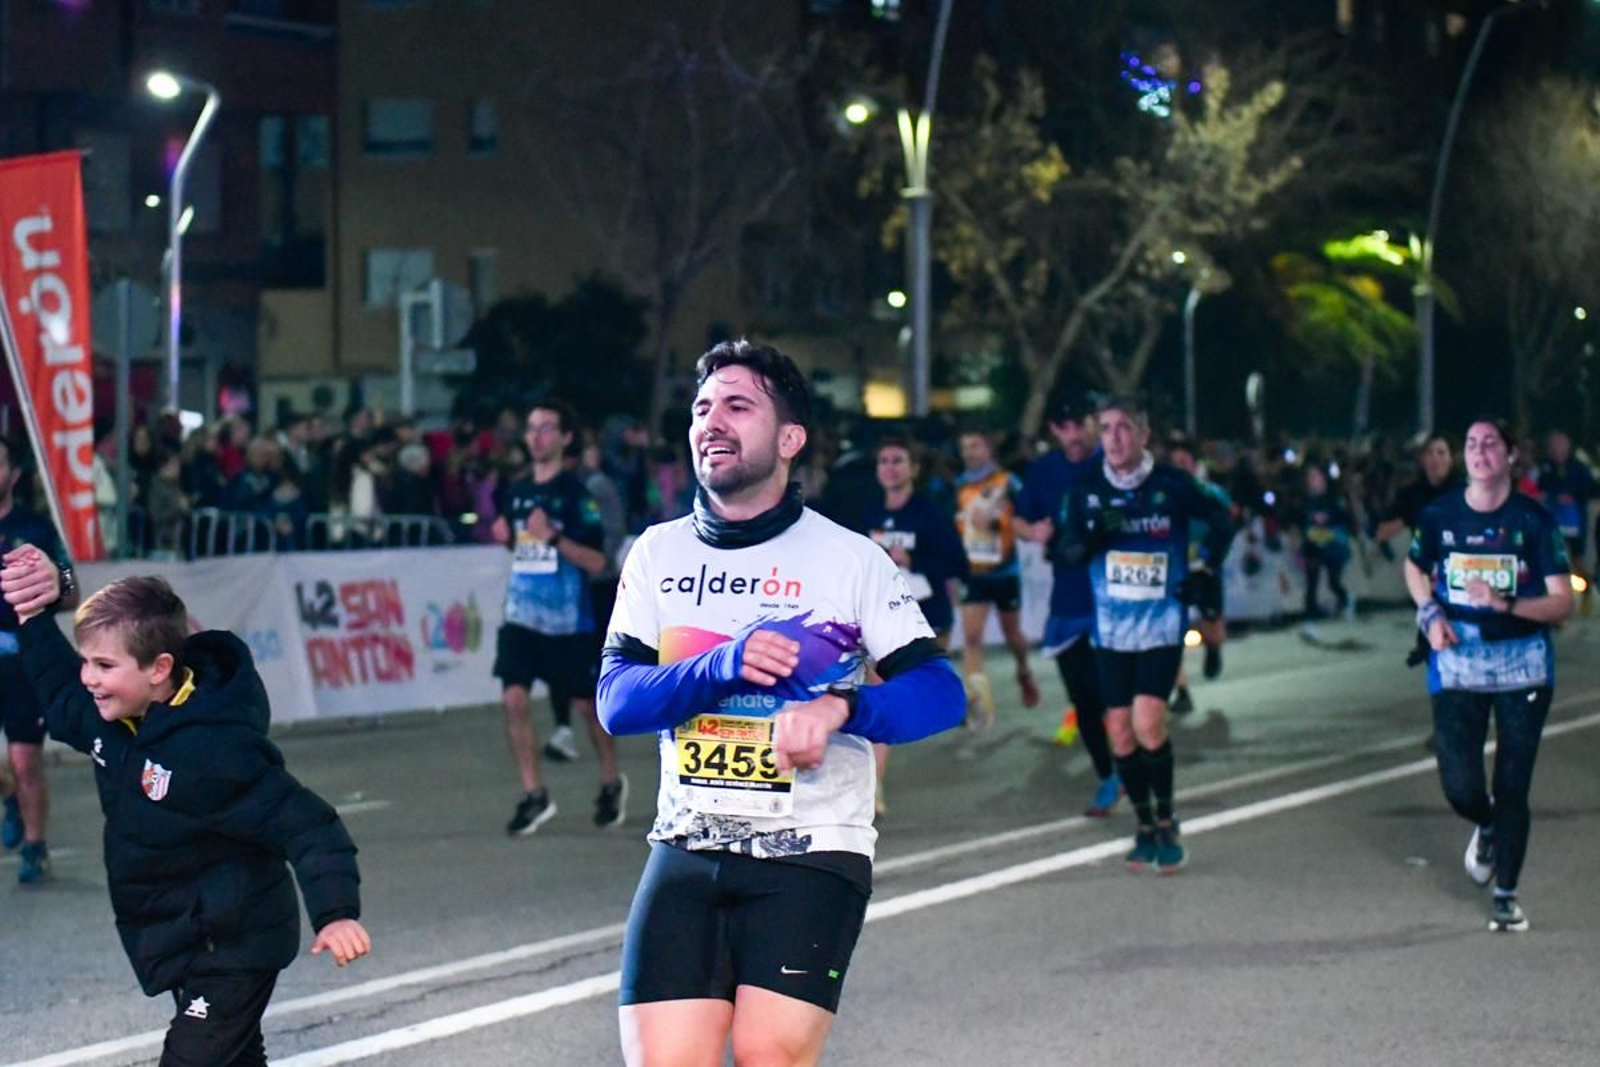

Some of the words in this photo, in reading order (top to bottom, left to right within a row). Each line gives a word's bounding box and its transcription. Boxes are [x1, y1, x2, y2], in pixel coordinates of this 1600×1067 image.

[661, 564, 802, 605] calderón
[1112, 565, 1162, 584] 8262
[295, 579, 339, 630] 42
[340, 577, 406, 630] SAN
[684, 741, 779, 780] 3459
